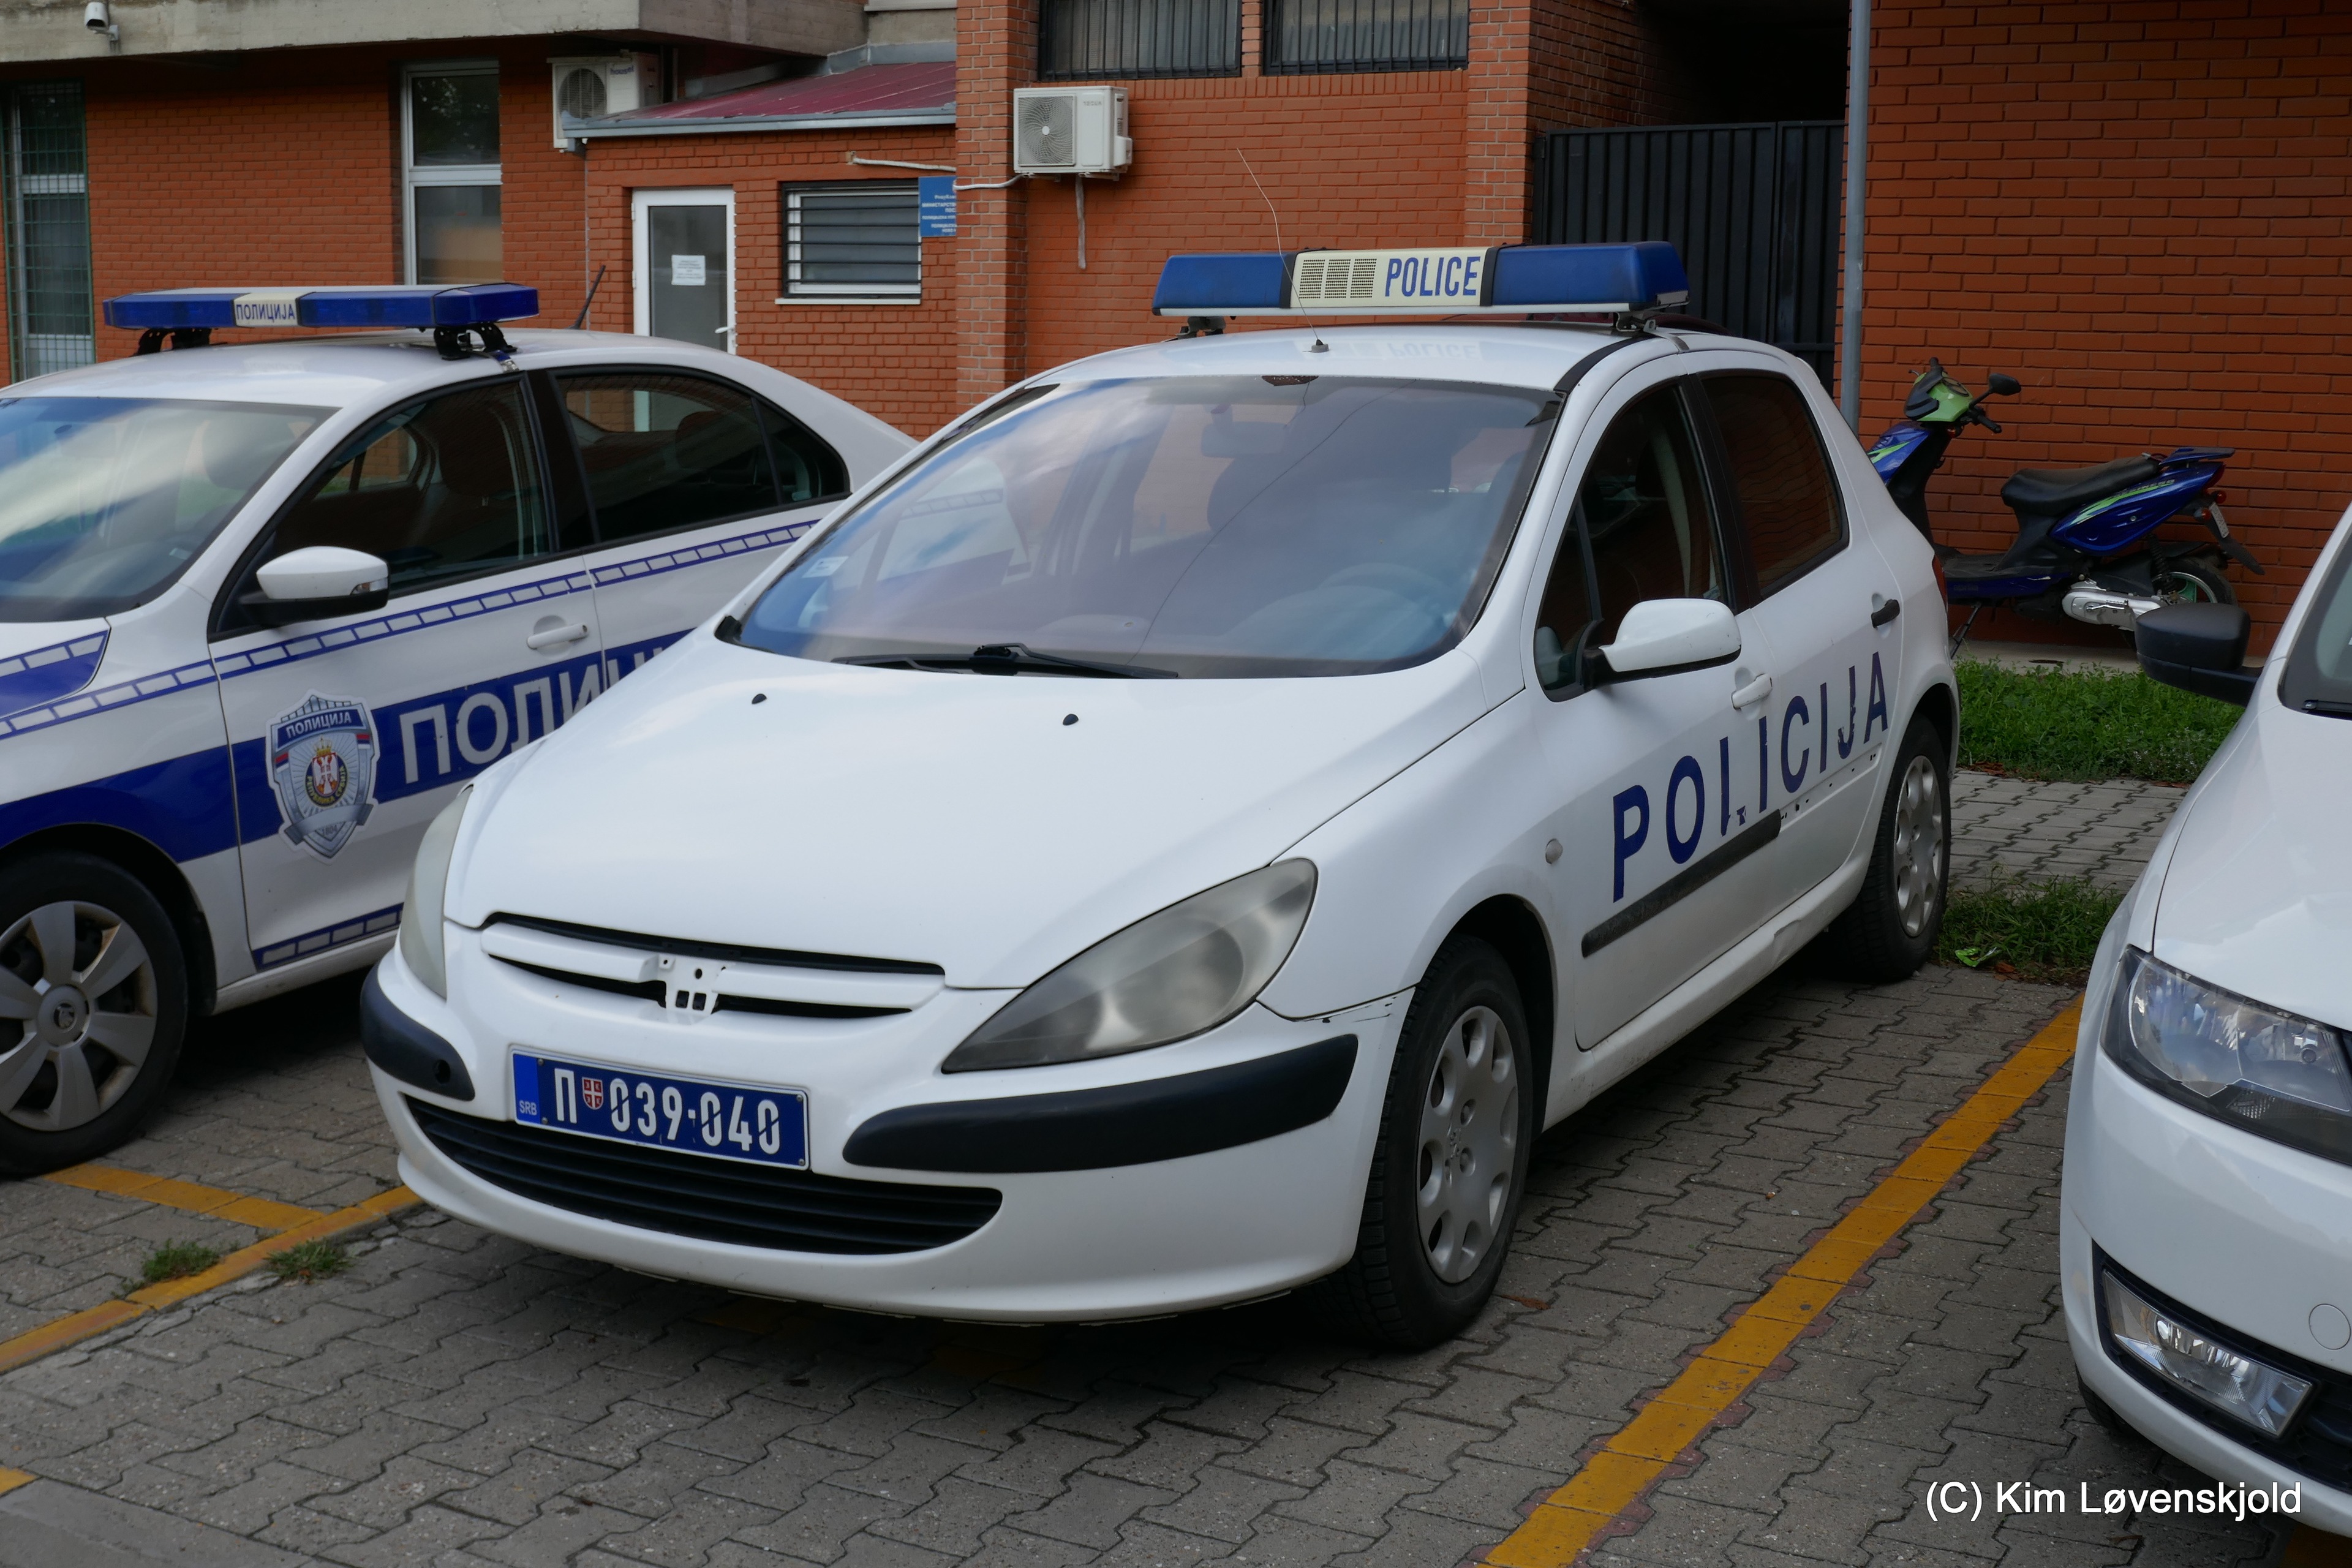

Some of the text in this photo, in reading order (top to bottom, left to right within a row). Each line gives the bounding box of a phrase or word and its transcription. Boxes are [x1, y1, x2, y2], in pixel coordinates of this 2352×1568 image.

[1385, 255, 1481, 297] POLICE
[236, 303, 295, 323] ПОЛИЦИЈА
[285, 711, 352, 739] ПОЛИЦИЈА
[399, 647, 663, 785] ПОЛИ
[1613, 651, 1888, 903] POLICIJA
[519, 1099, 537, 1116] SRB
[609, 1078, 780, 1155] 039-040
